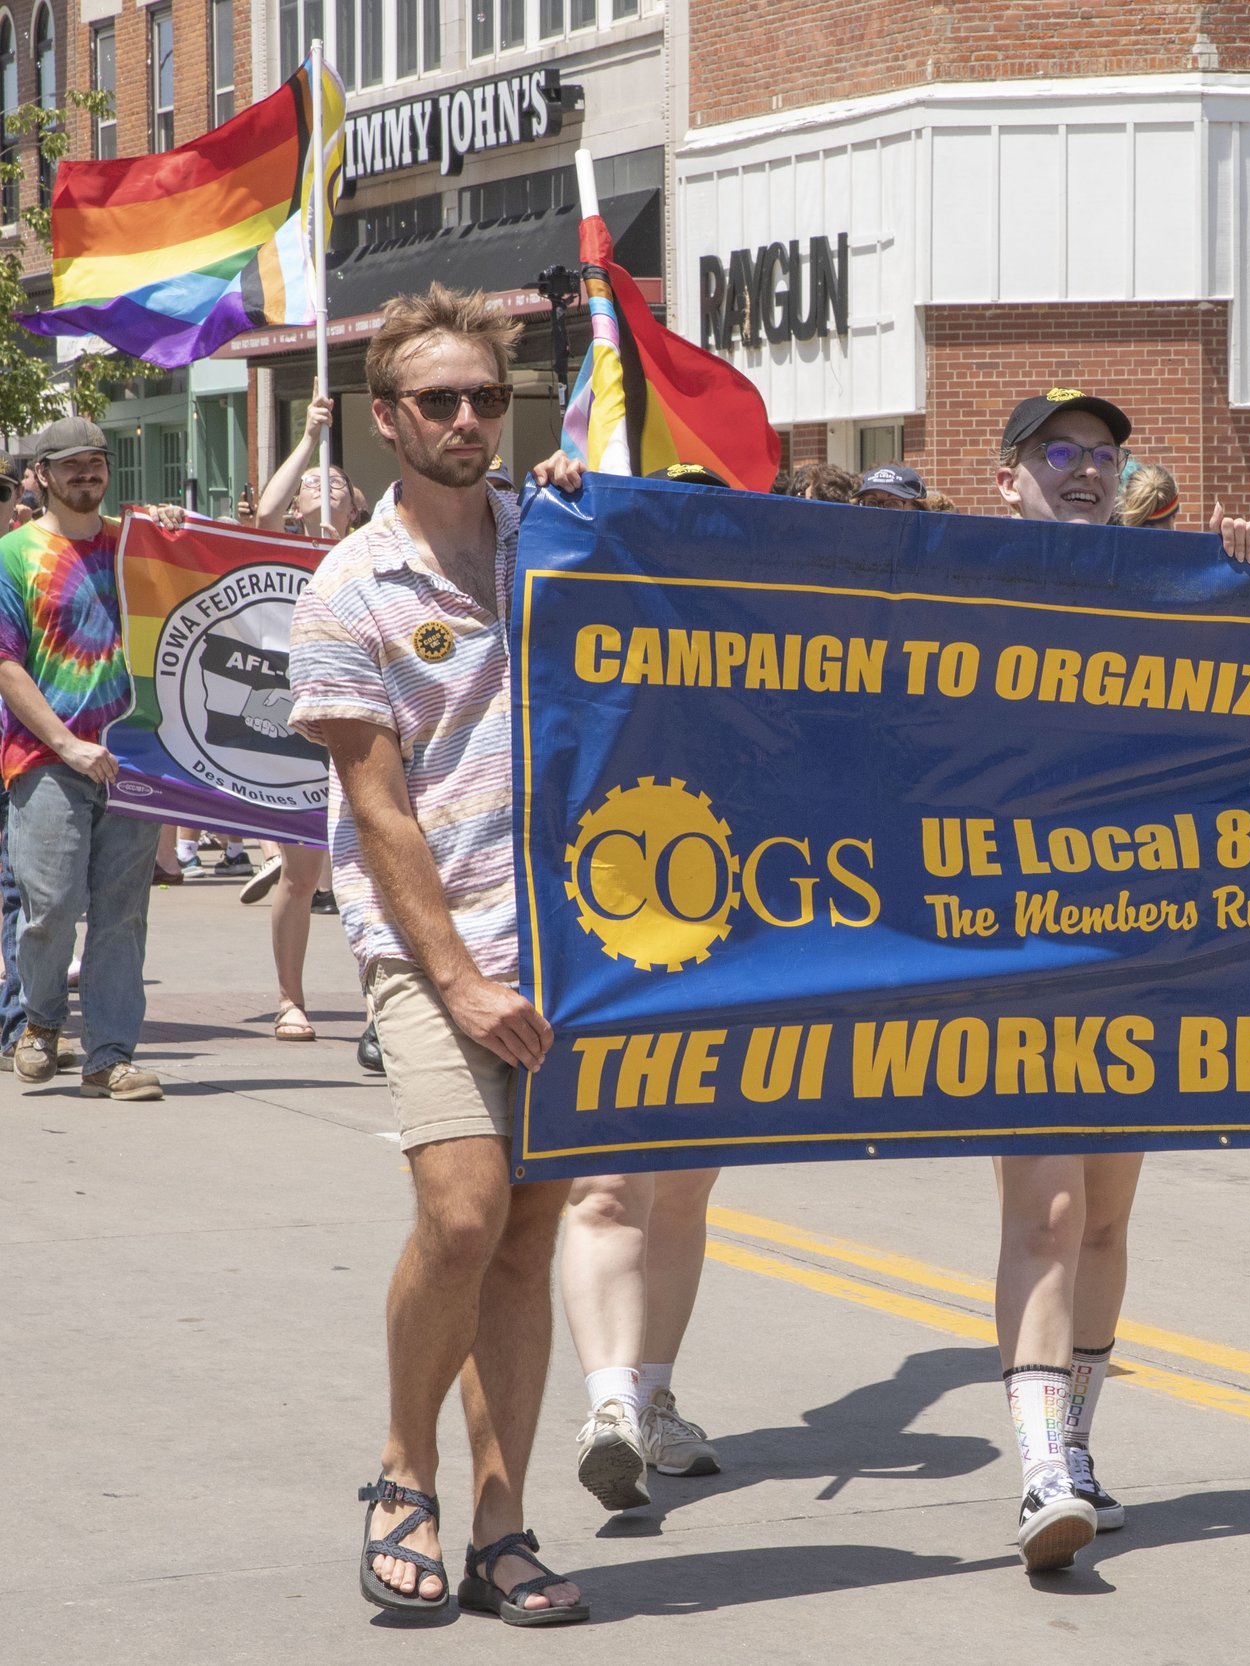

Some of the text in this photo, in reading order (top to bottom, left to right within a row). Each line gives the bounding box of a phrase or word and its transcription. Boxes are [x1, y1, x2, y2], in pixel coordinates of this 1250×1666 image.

[344, 69, 549, 181] IMMY JOHN'S
[699, 232, 848, 350] RAYGUN
[160, 571, 309, 677] IOWA FEDERATIO
[423, 632, 441, 645] COGS
[574, 624, 888, 694] CAMPAIGN
[902, 640, 980, 697] TO
[225, 651, 290, 680] AFL-
[192, 760, 330, 805] Des Moines Iow
[576, 829, 881, 928] COGS
[921, 817, 1002, 878] UE
[1013, 813, 1200, 875] Local
[924, 895, 999, 939] The
[1015, 890, 1198, 937] Members
[572, 1029, 728, 1111] THE
[740, 1024, 833, 1103] UI
[852, 1015, 1155, 1098] WORKS
